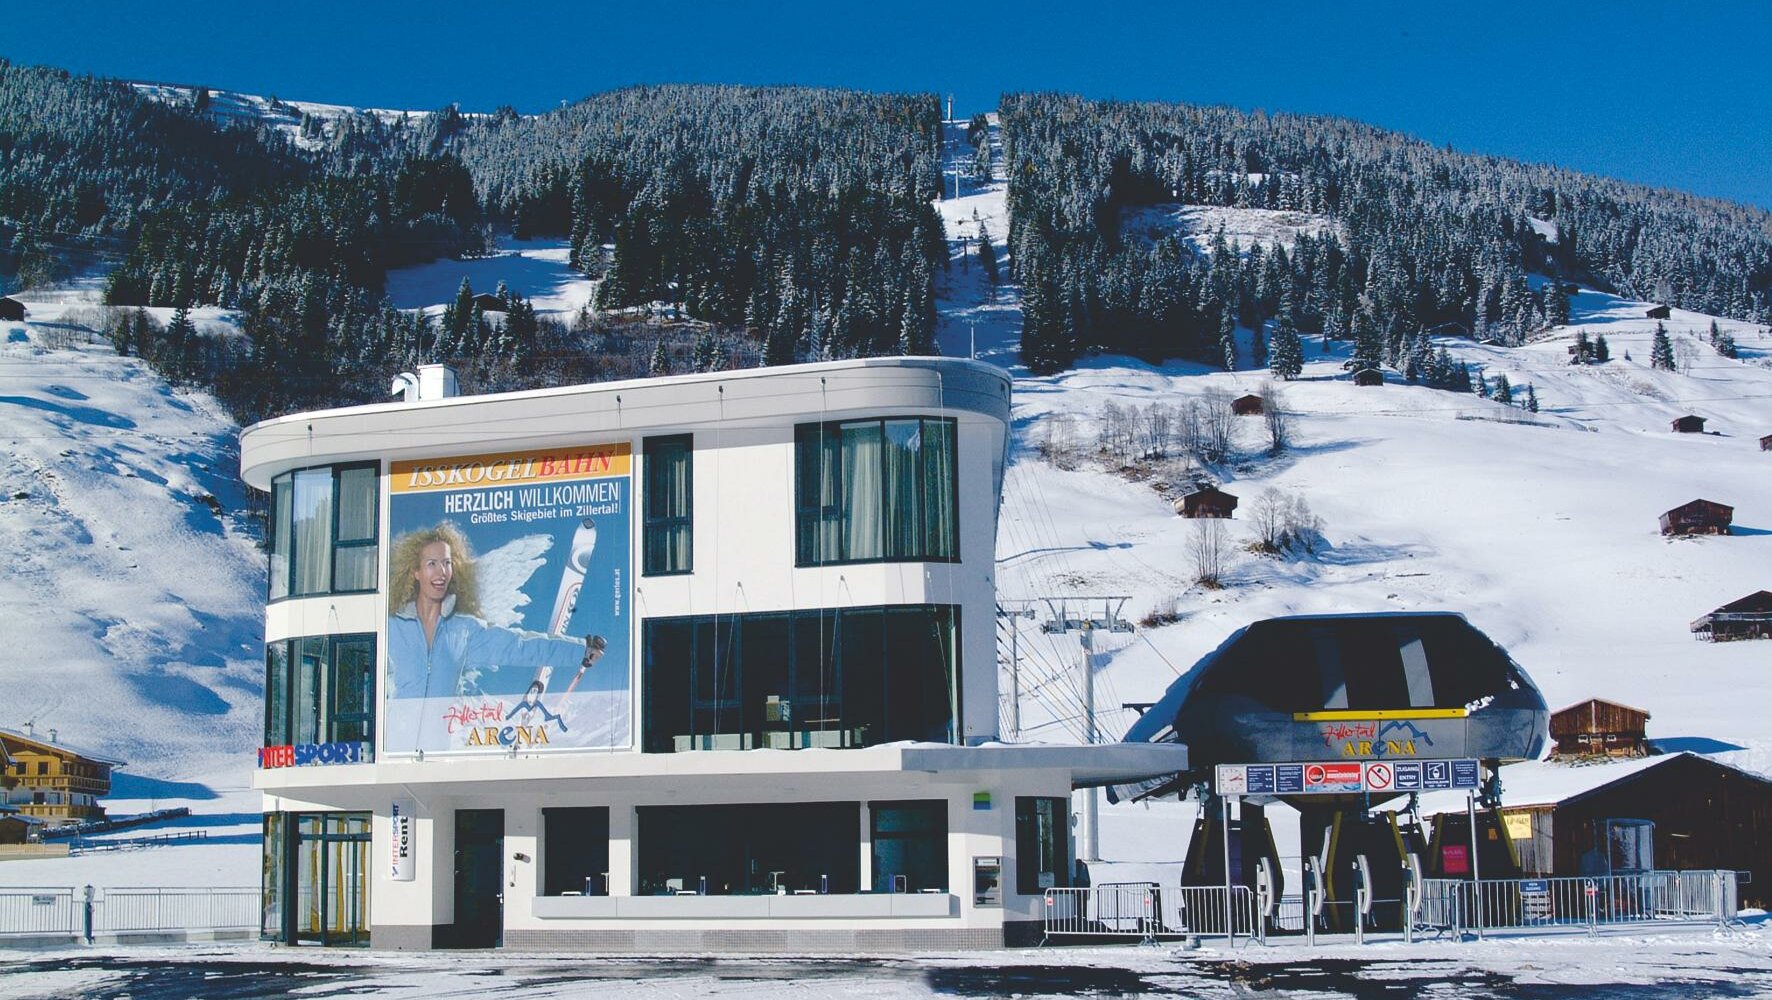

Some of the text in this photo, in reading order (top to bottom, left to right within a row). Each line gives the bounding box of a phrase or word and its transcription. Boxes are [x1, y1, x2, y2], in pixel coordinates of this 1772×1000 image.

[445, 481, 619, 513] HERZLICH WILLKOMMEN
[470, 502, 618, 524] Größtes Skigebiet im Zillertal!
[257, 741, 362, 769] INTERSPORT
[392, 803, 400, 865] INTERSPORT
[400, 816, 409, 857] Rent
